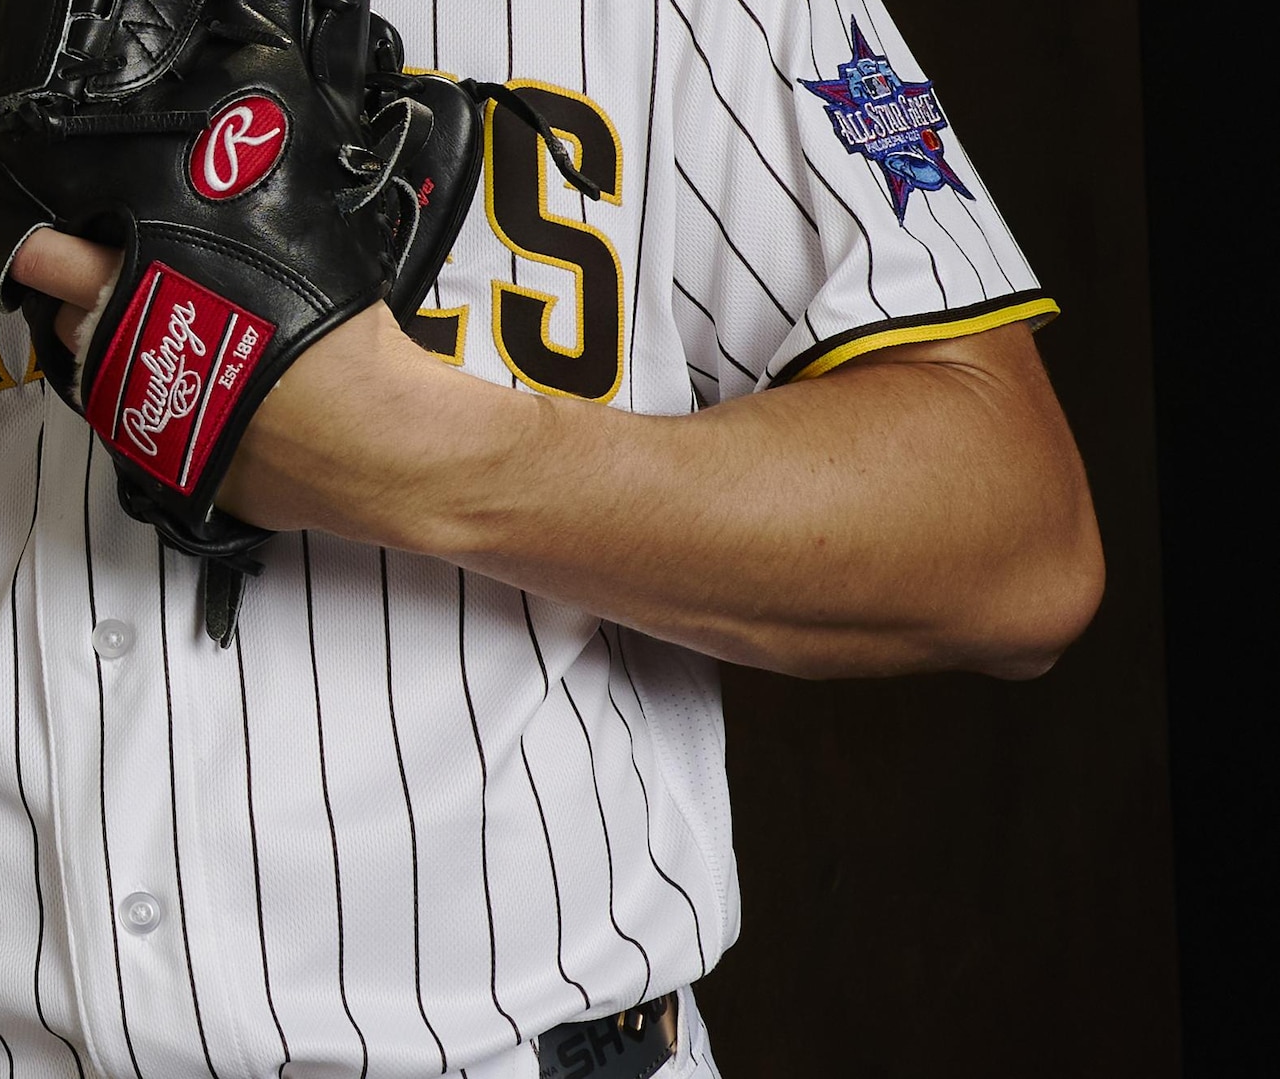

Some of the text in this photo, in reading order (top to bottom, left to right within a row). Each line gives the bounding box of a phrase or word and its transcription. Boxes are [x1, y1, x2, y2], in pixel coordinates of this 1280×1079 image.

[204, 106, 281, 192] R
[834, 109, 876, 145] ALL
[123, 300, 207, 457] Rawlings
[218, 326, 260, 391] Est. 1887
